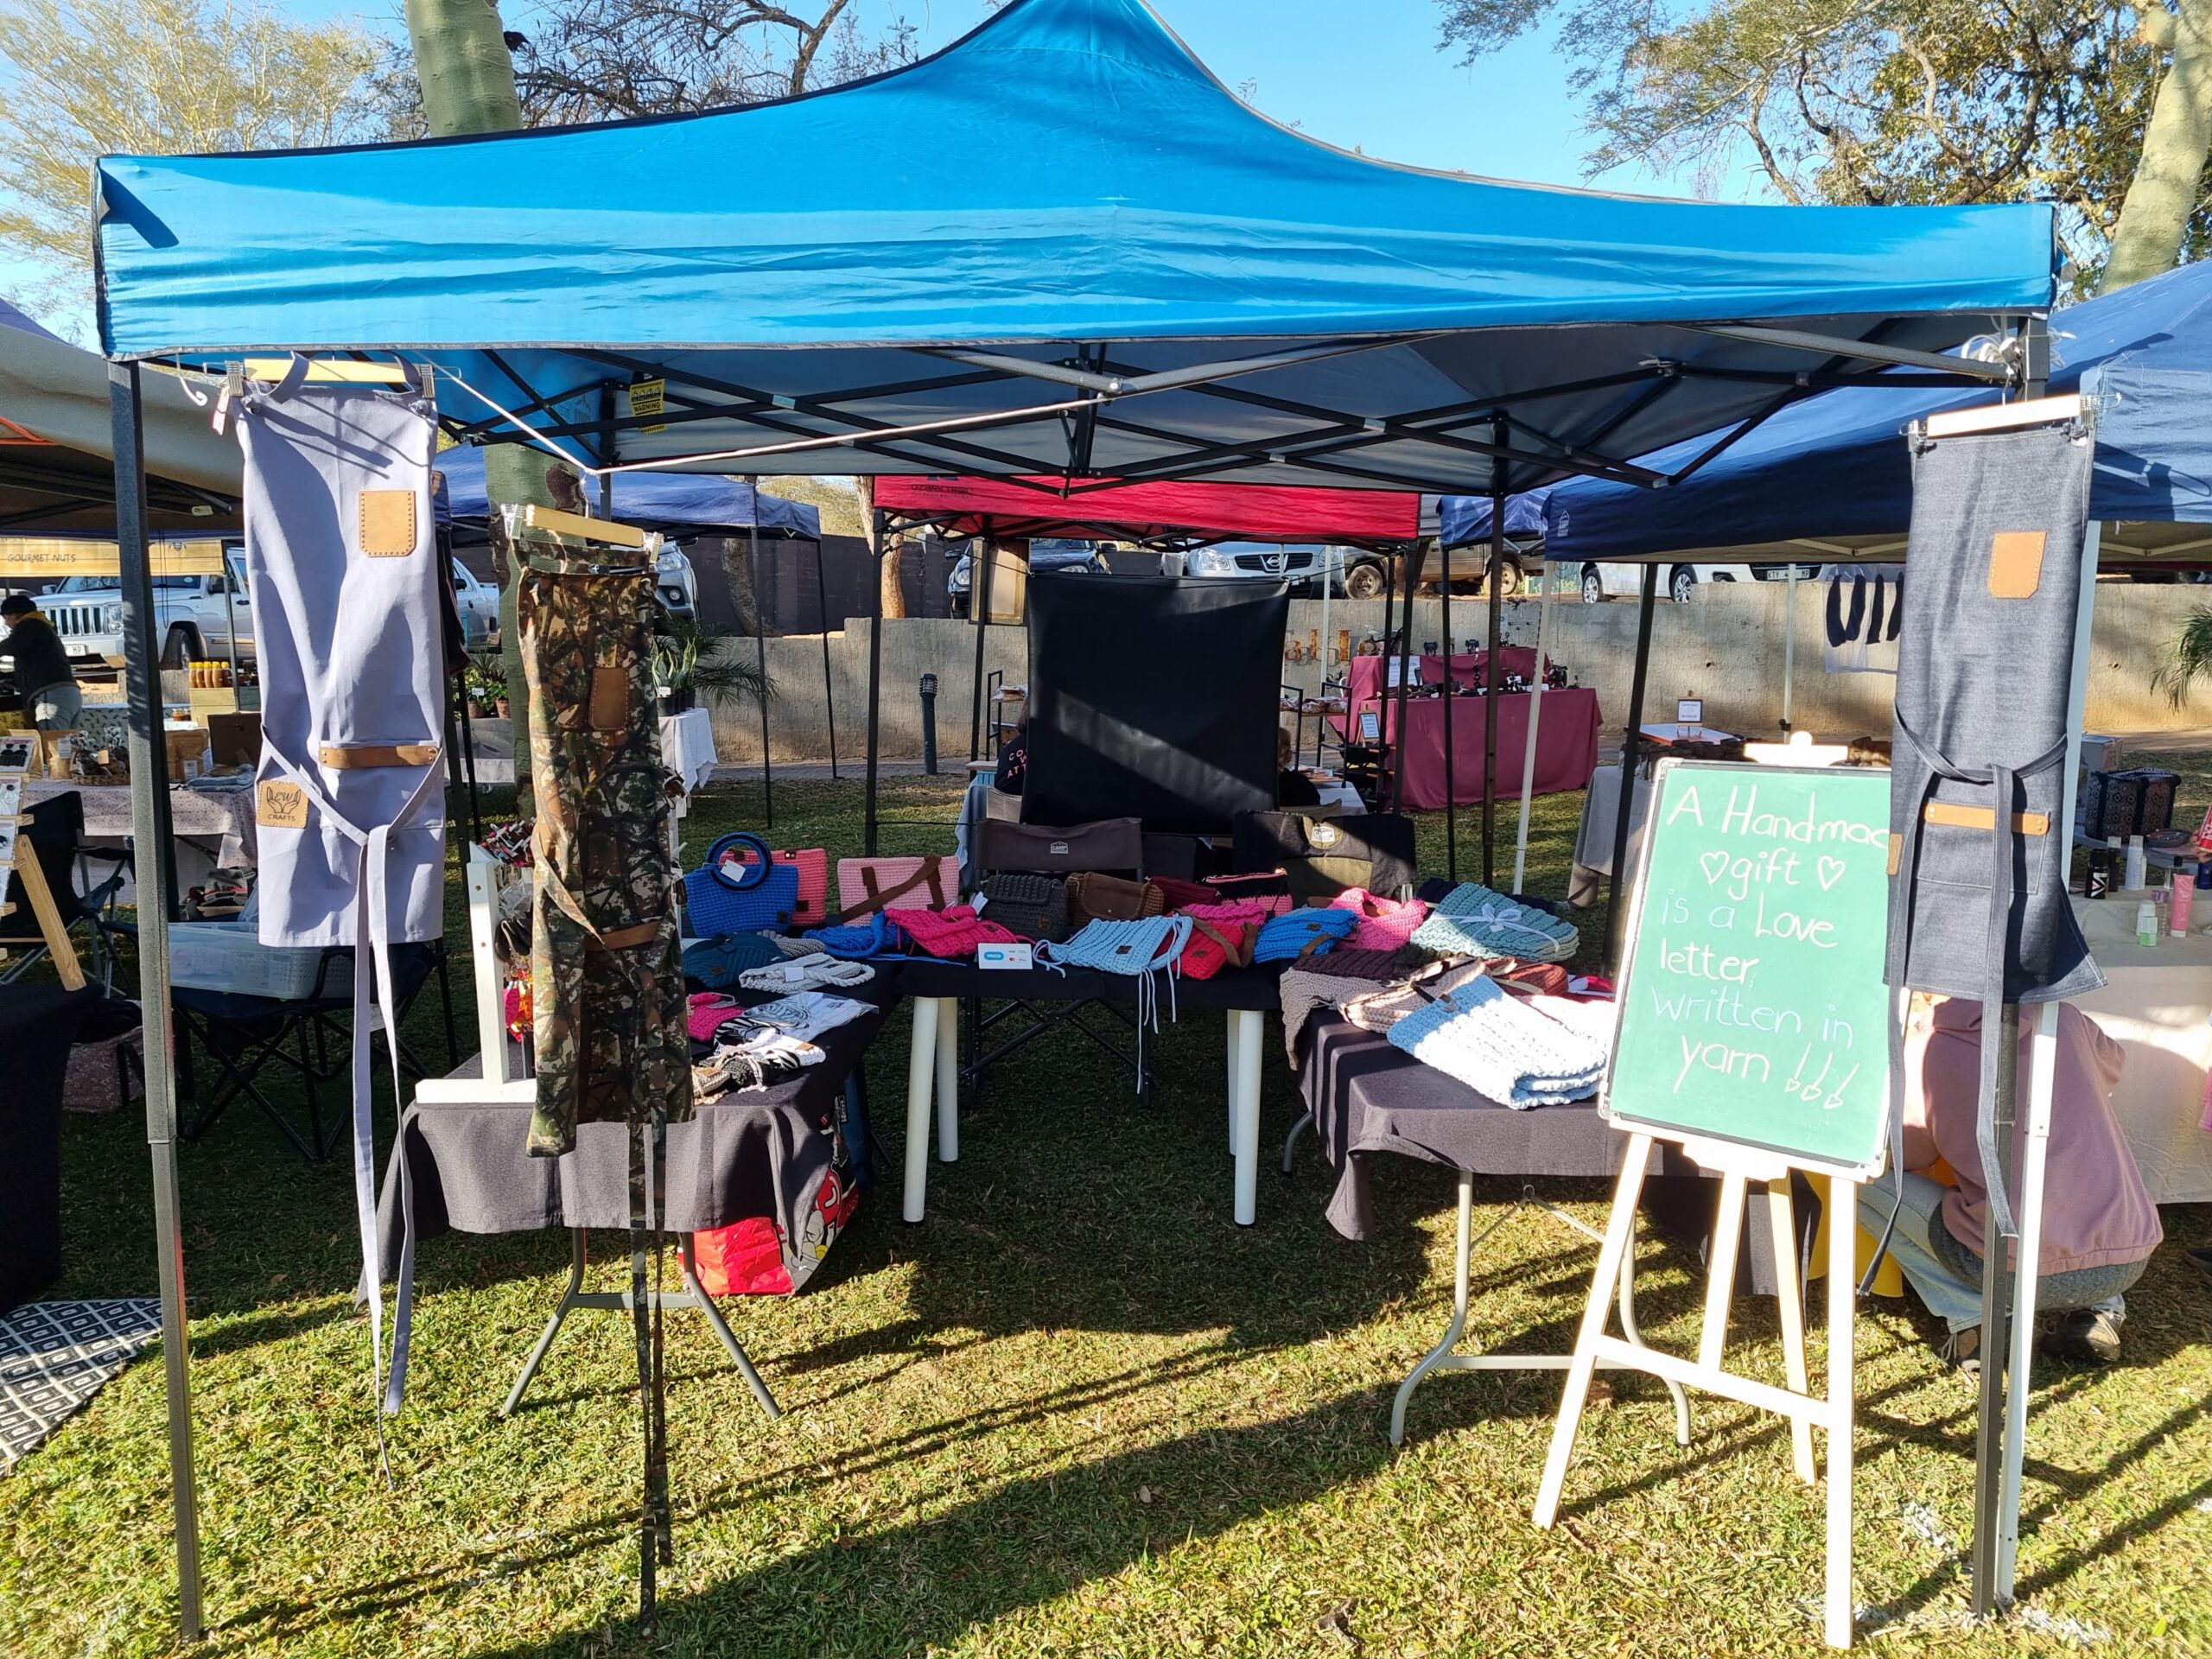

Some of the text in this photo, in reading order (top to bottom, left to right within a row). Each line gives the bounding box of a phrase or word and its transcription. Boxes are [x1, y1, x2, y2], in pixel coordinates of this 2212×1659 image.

[634, 402, 660, 412] WARNING
[7, 553, 76, 563] GOURMET NUTS
[1667, 785, 1891, 849] A Handma
[1727, 848, 1801, 900] gift
[1661, 890, 1839, 949] is a Love
[1660, 937, 1760, 983] letter
[1651, 987, 1854, 1050] written in
[1674, 1035, 1770, 1094] yarn
